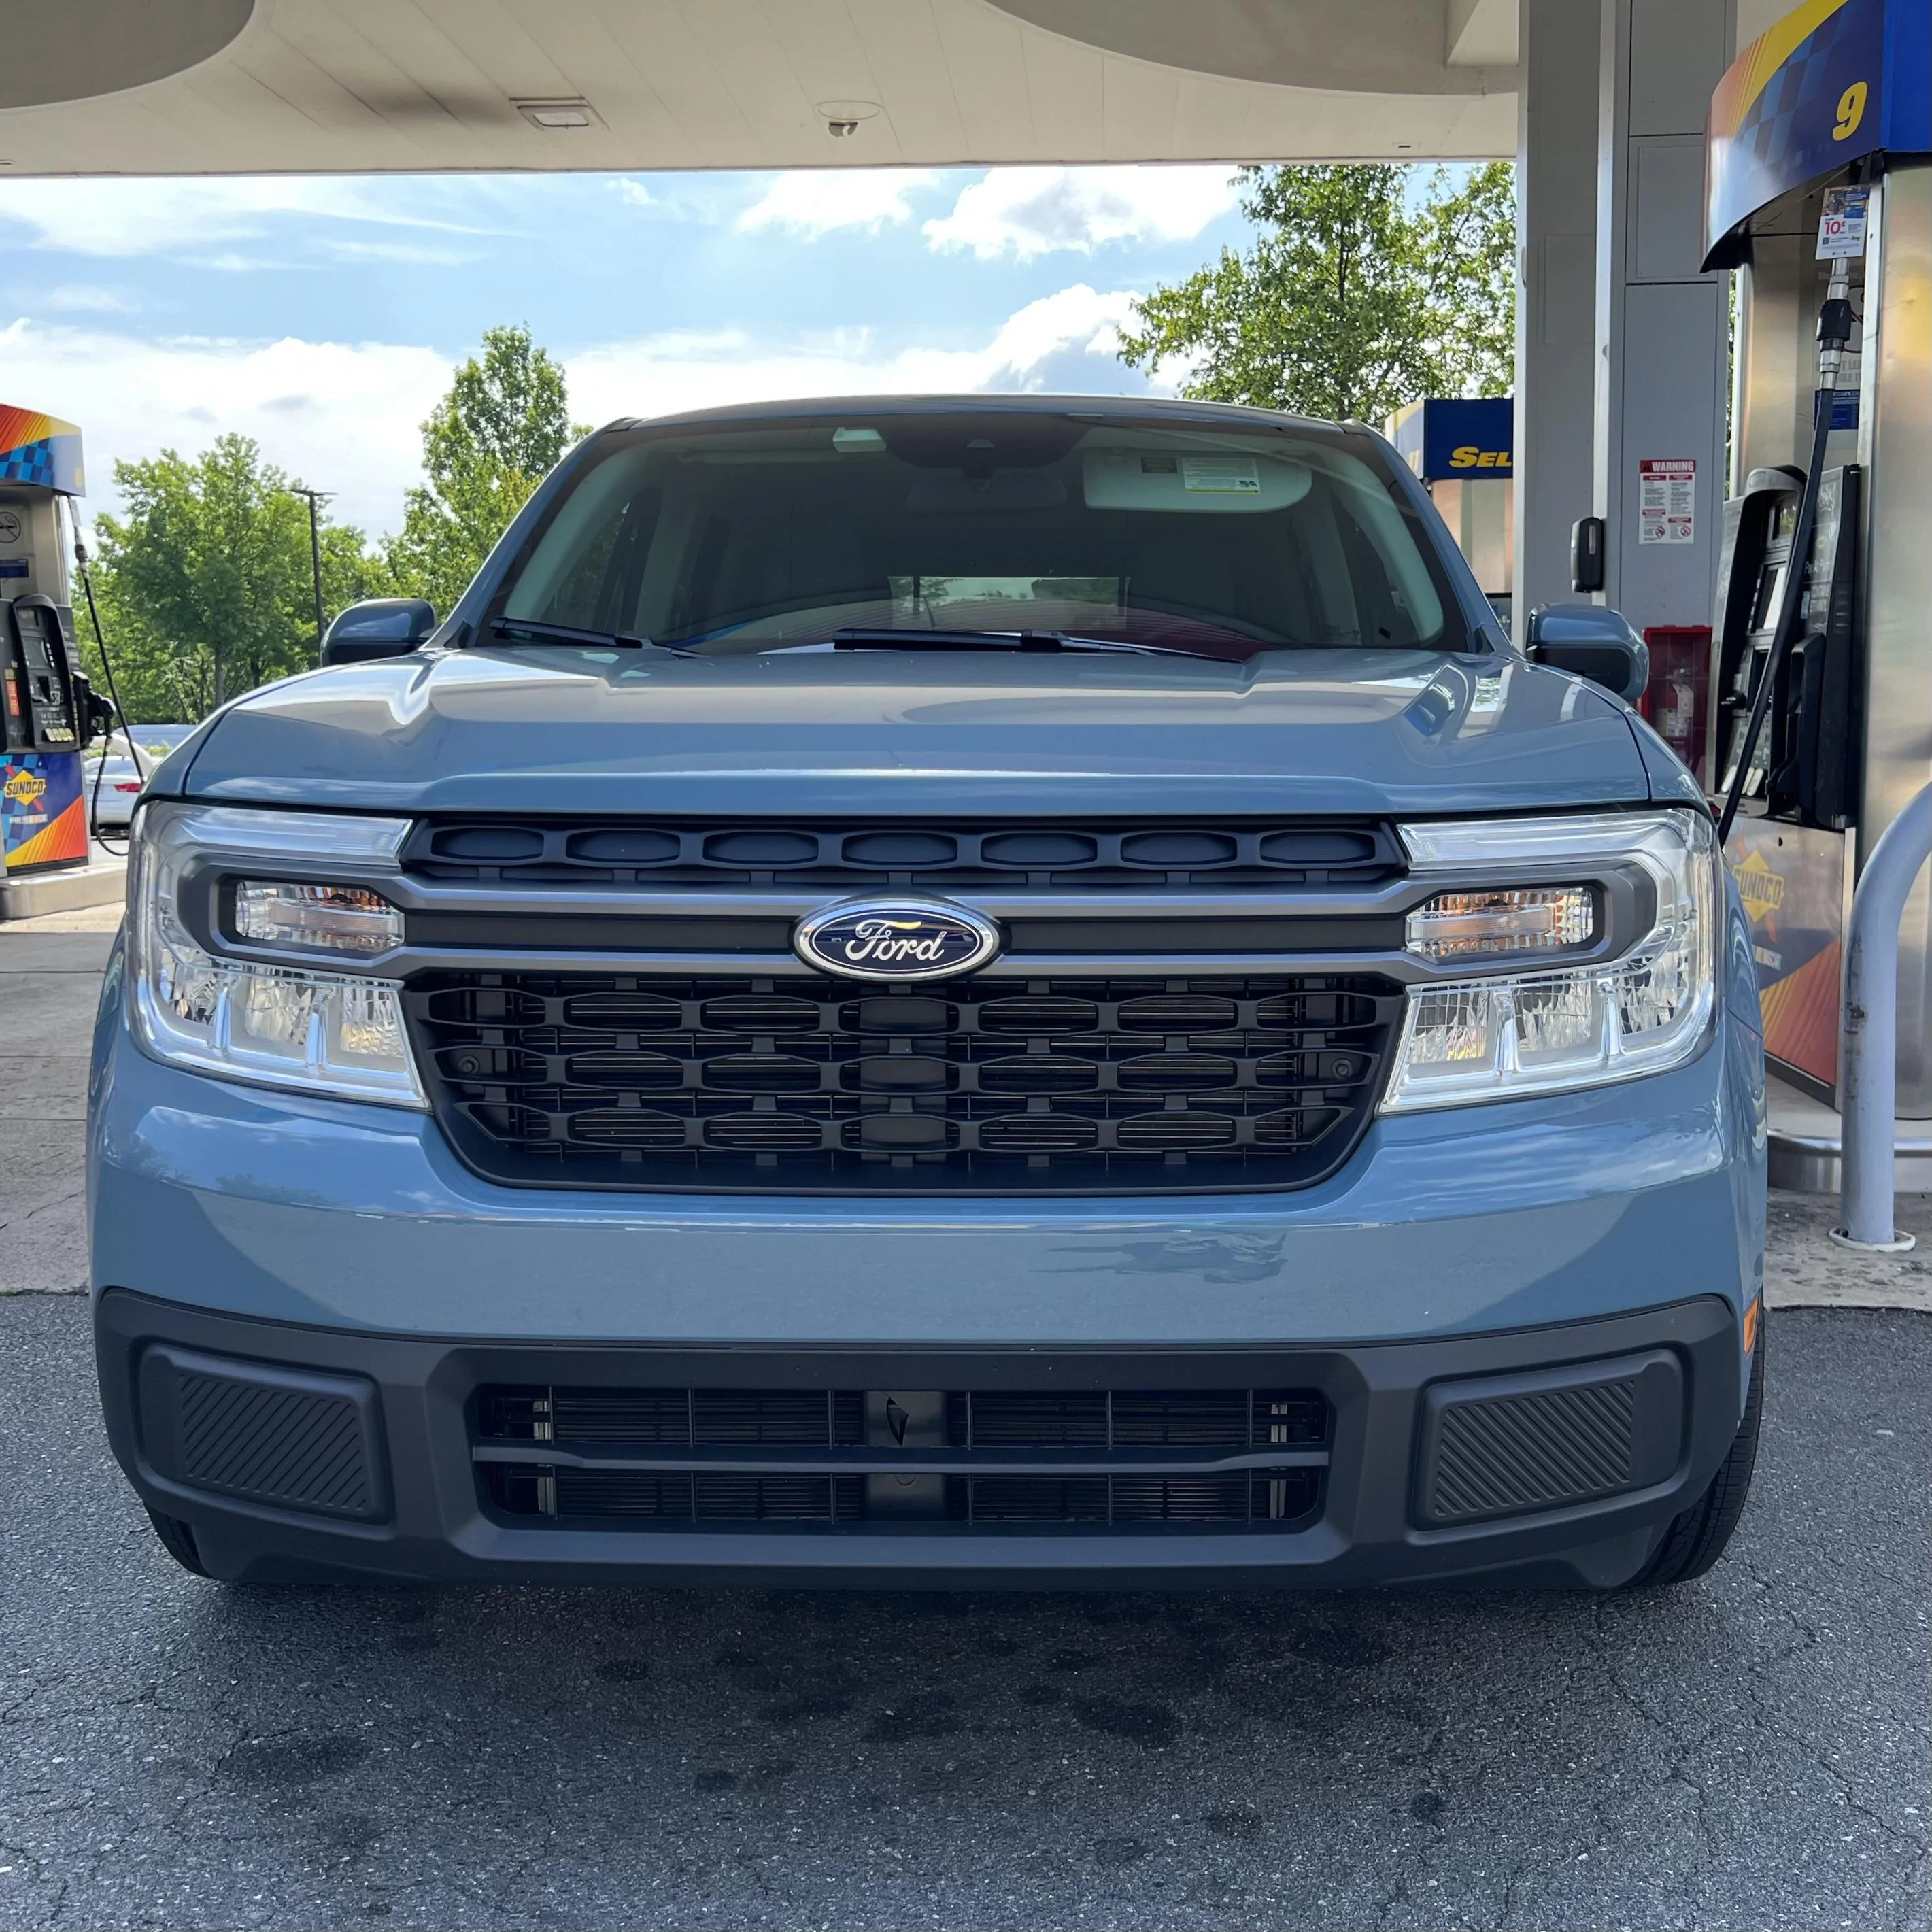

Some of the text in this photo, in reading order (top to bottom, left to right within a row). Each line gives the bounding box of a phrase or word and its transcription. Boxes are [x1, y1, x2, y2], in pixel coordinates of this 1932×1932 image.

[1832, 81, 1867, 141] 9
[1651, 461, 1694, 471] WARNING
[6, 781, 44, 795] SUNOCO
[845, 919, 947, 961] Ford
